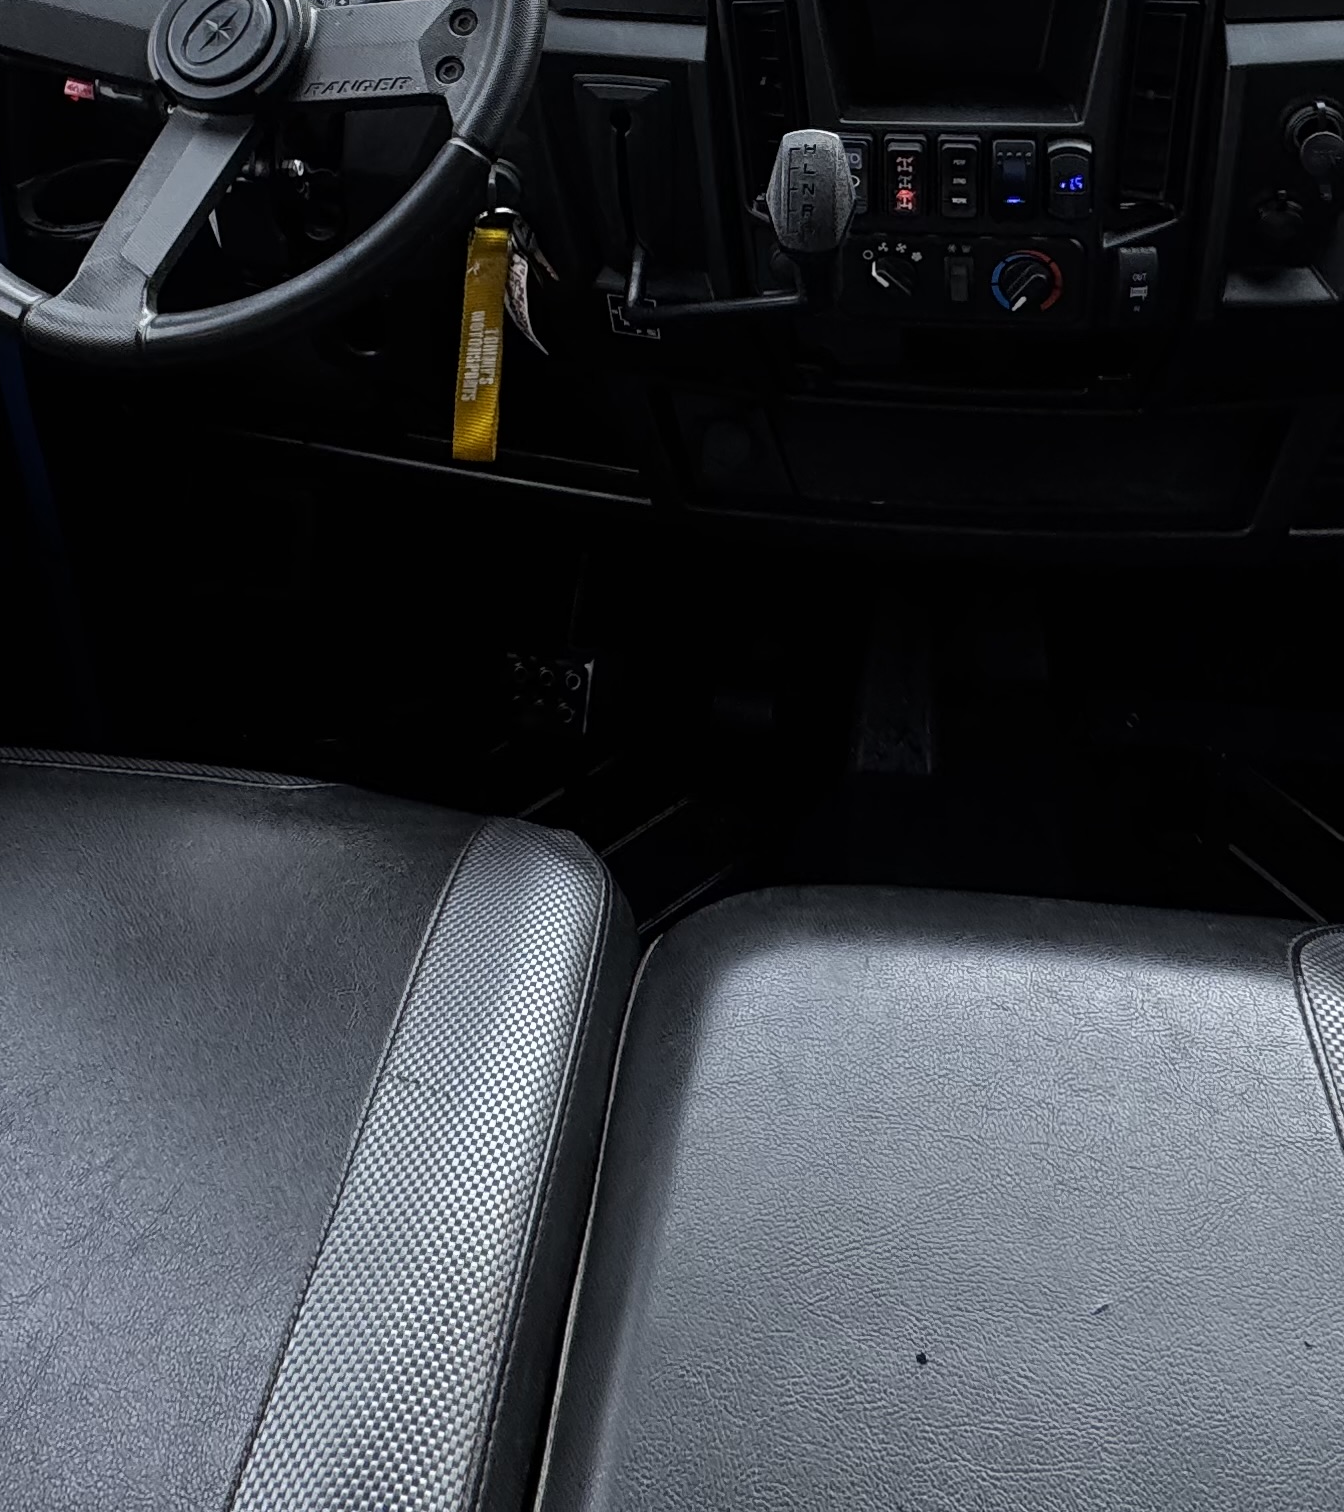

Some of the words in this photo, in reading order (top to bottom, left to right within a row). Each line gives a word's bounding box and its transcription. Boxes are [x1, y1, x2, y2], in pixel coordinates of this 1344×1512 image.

[305, 76, 414, 95] RANGER
[803, 143, 817, 155] H
[803, 163, 817, 175] L
[802, 183, 815, 196] N
[802, 203, 814, 217] R
